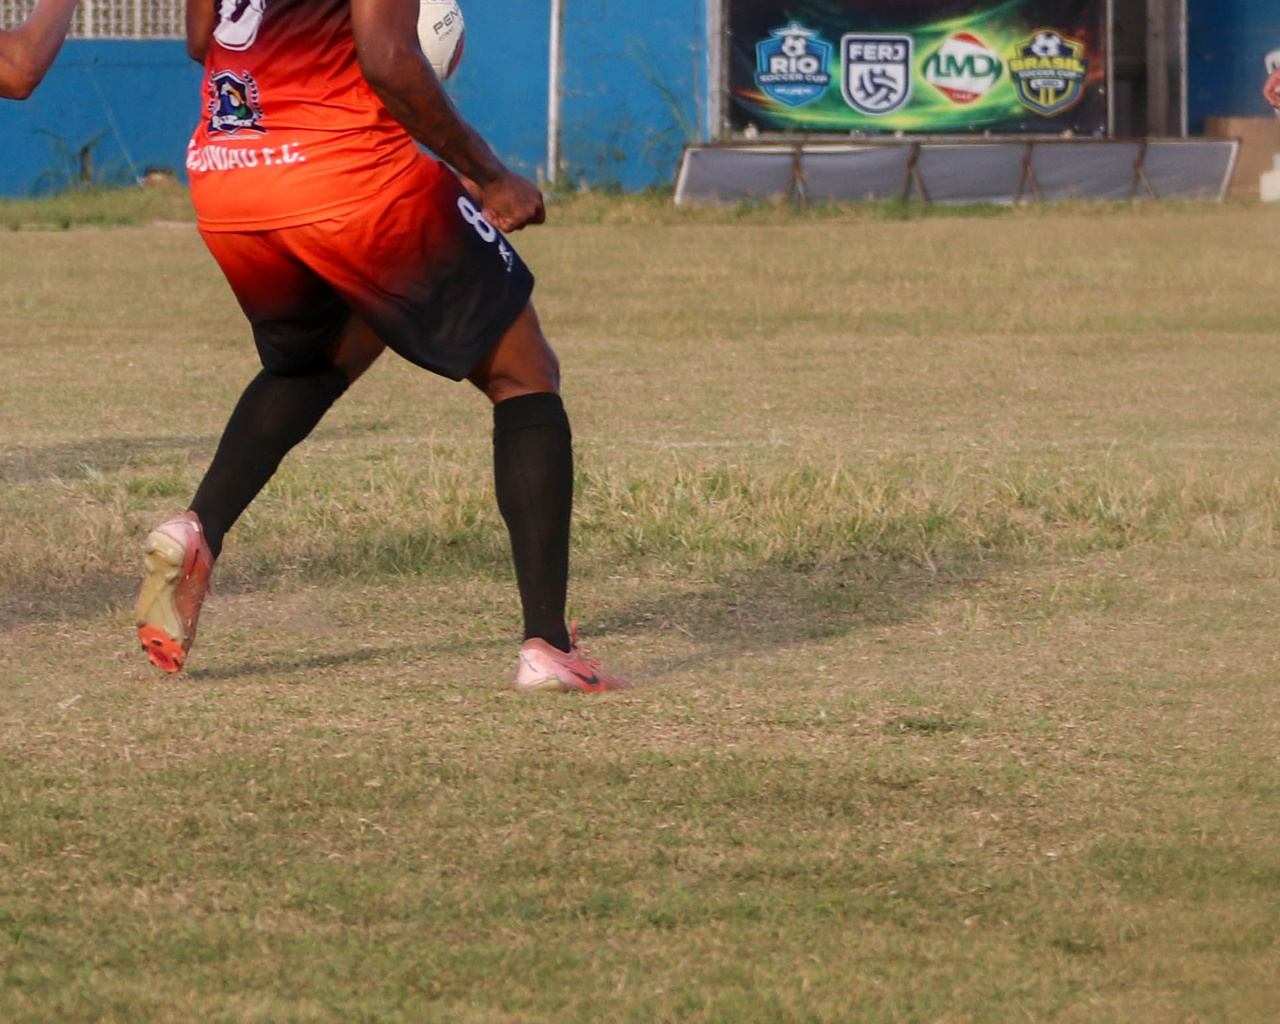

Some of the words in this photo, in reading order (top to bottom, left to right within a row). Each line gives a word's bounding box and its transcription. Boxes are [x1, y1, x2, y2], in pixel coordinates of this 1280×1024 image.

[849, 43, 903, 61] FERJ
[770, 56, 819, 73] RIO
[928, 53, 997, 78] LMD
[1010, 57, 1084, 72] BRASIL
[457, 196, 496, 243] 8
